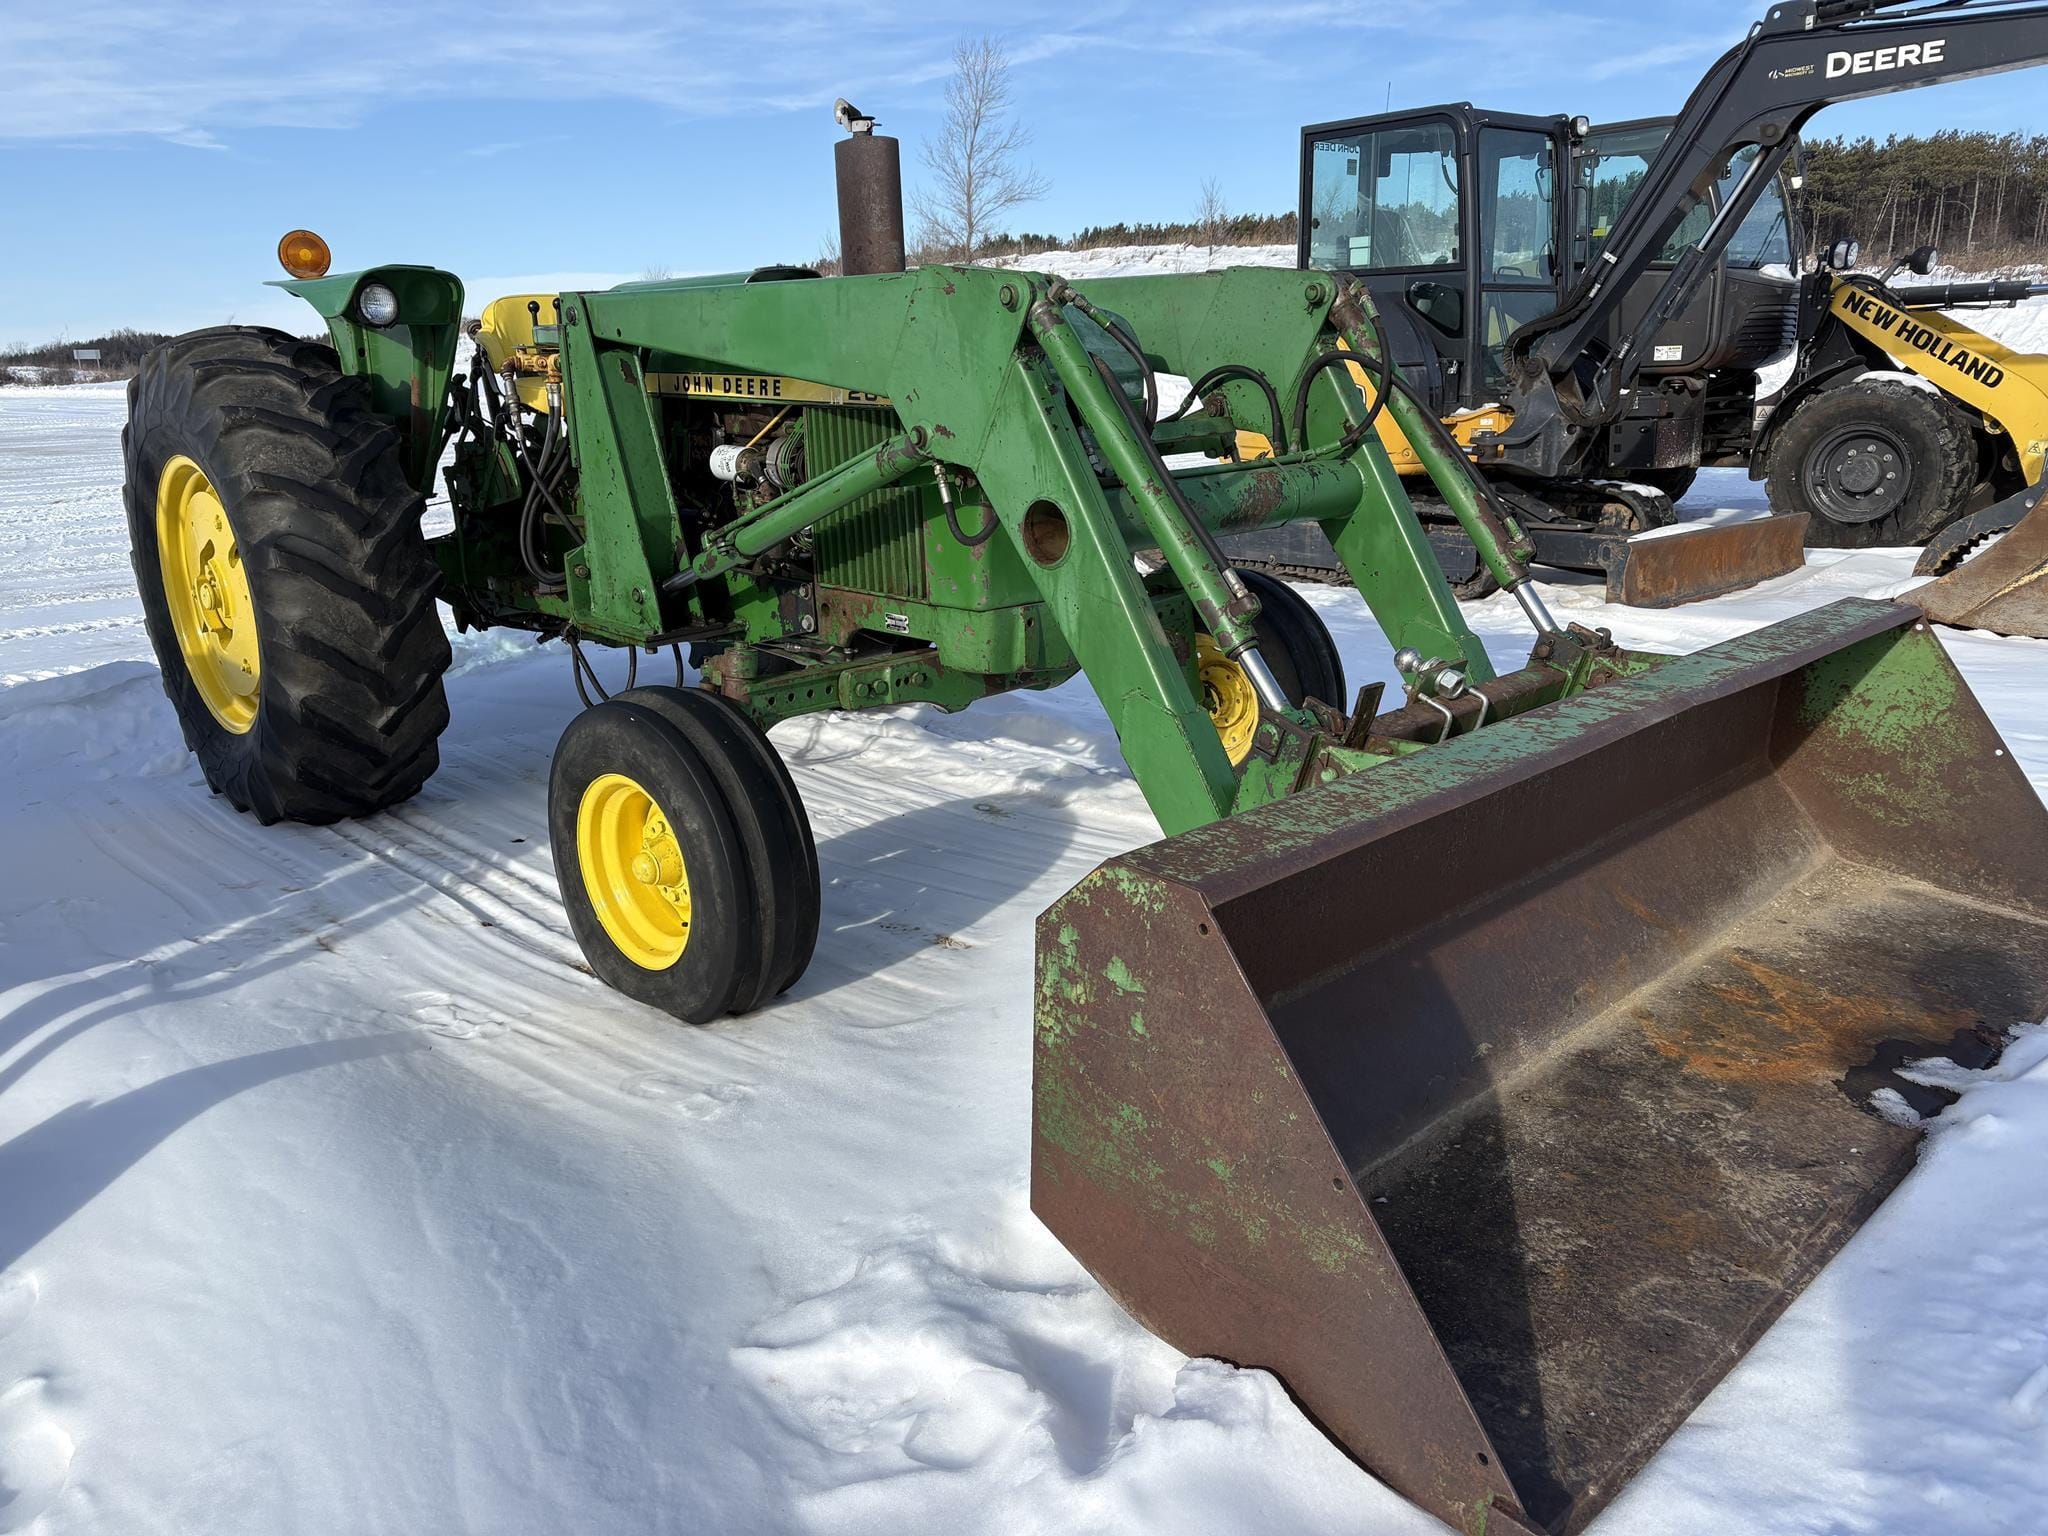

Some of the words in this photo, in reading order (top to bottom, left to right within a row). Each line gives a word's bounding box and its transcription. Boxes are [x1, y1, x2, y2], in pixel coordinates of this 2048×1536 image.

[1826, 39, 1946, 79] DEERE
[1841, 291, 1900, 331] NEW
[1894, 319, 2005, 389] HOLLAND
[673, 375, 713, 393] JOHN
[723, 377, 781, 397] DEERE
